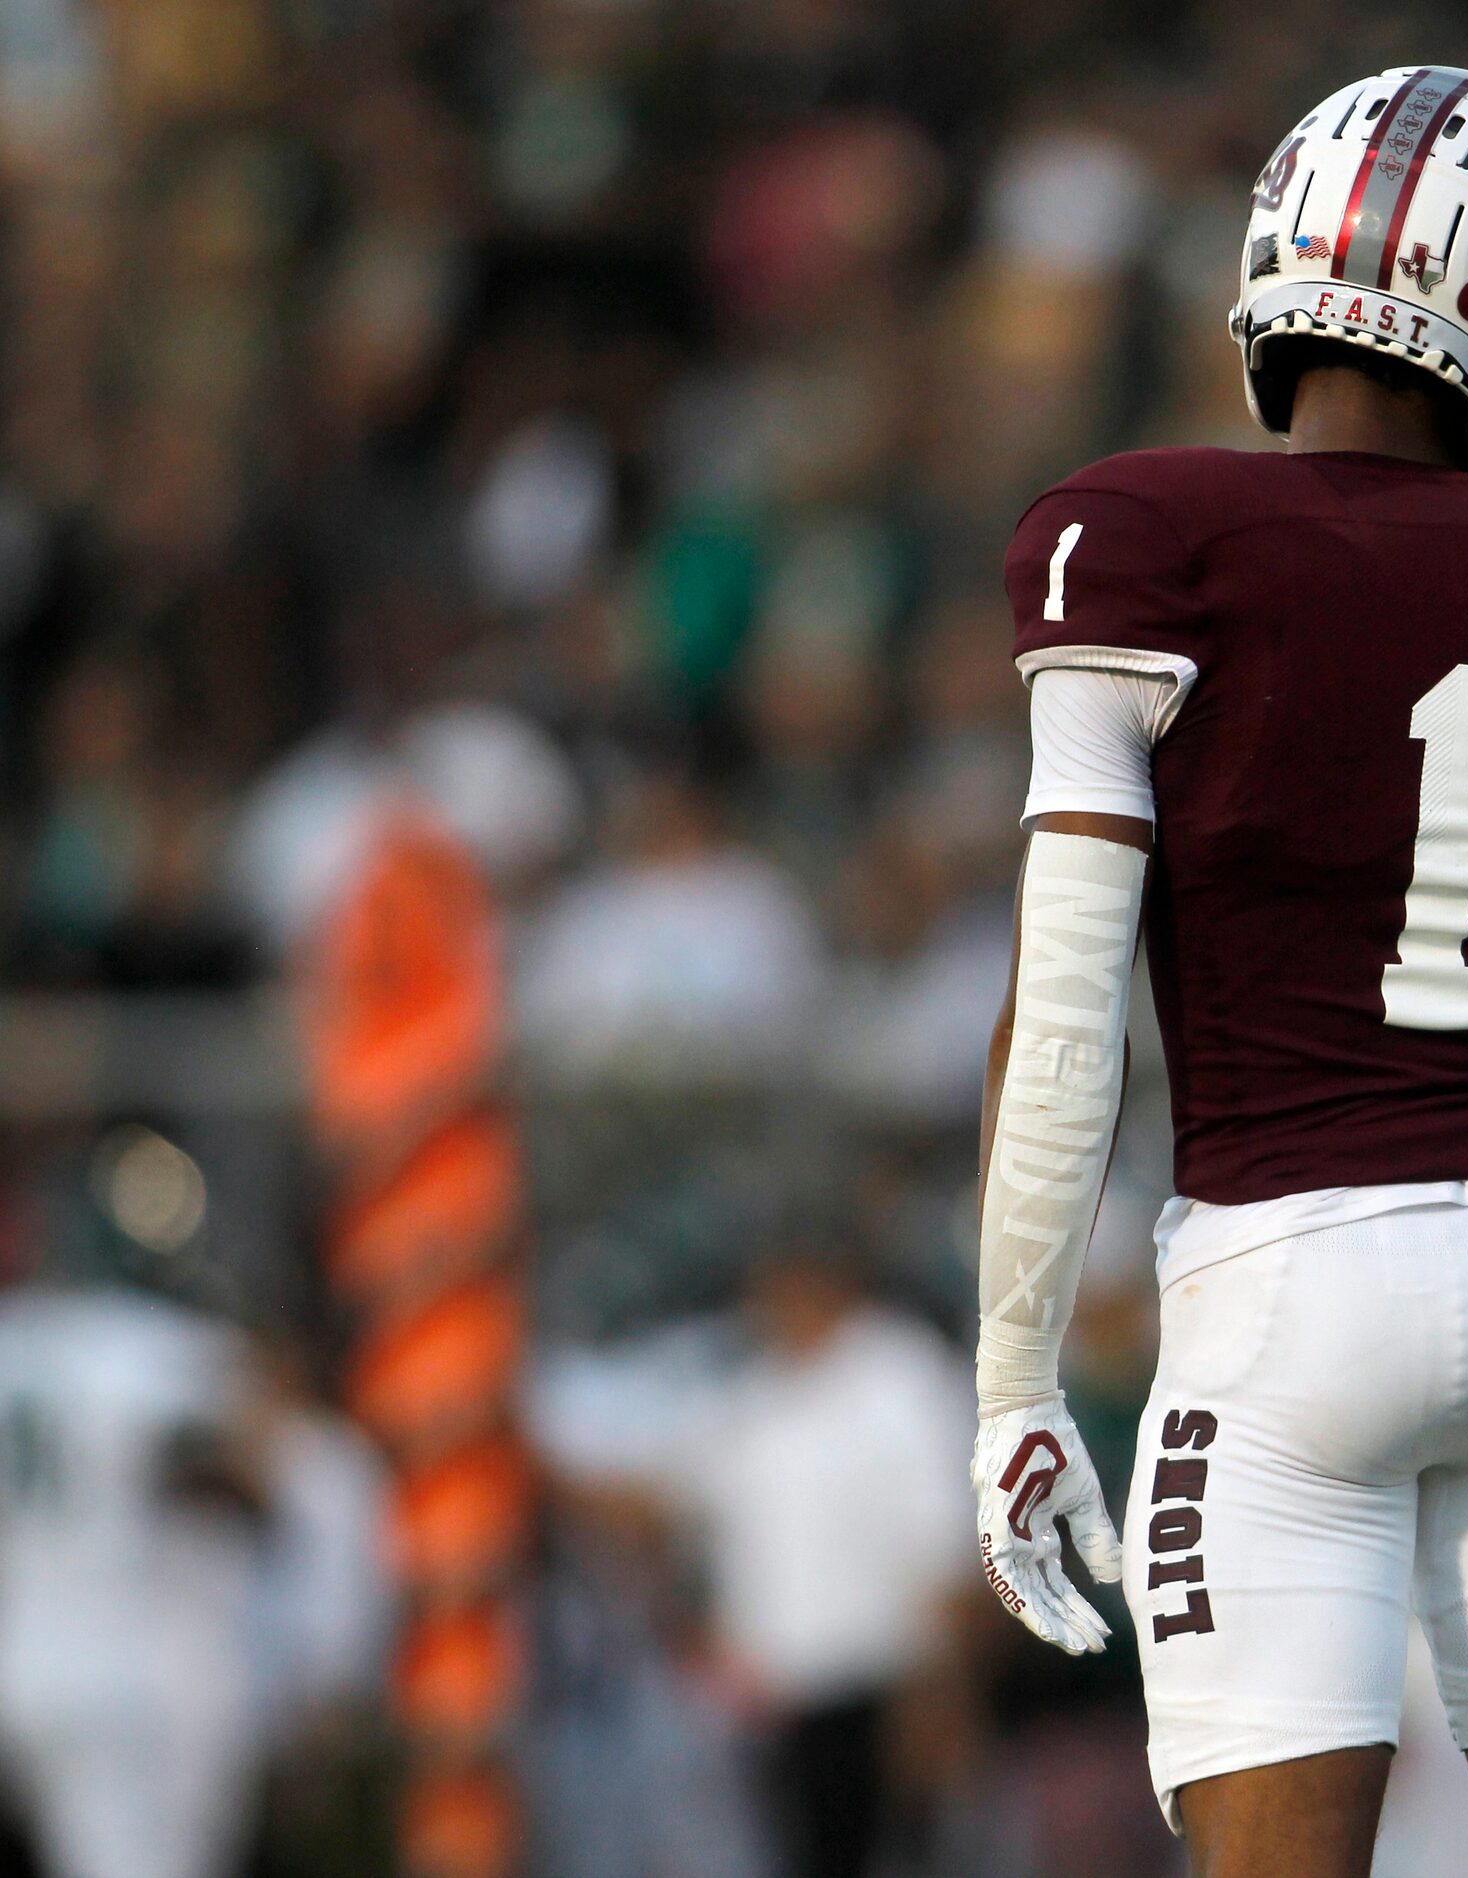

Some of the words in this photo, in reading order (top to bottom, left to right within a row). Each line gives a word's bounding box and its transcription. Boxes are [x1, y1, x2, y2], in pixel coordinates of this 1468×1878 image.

[1043, 522, 1084, 622] 1
[1000, 875, 1132, 1201] NXTRND
[980, 1532, 1027, 1614] SOONERS
[1147, 1409, 1218, 1643] LIONS
